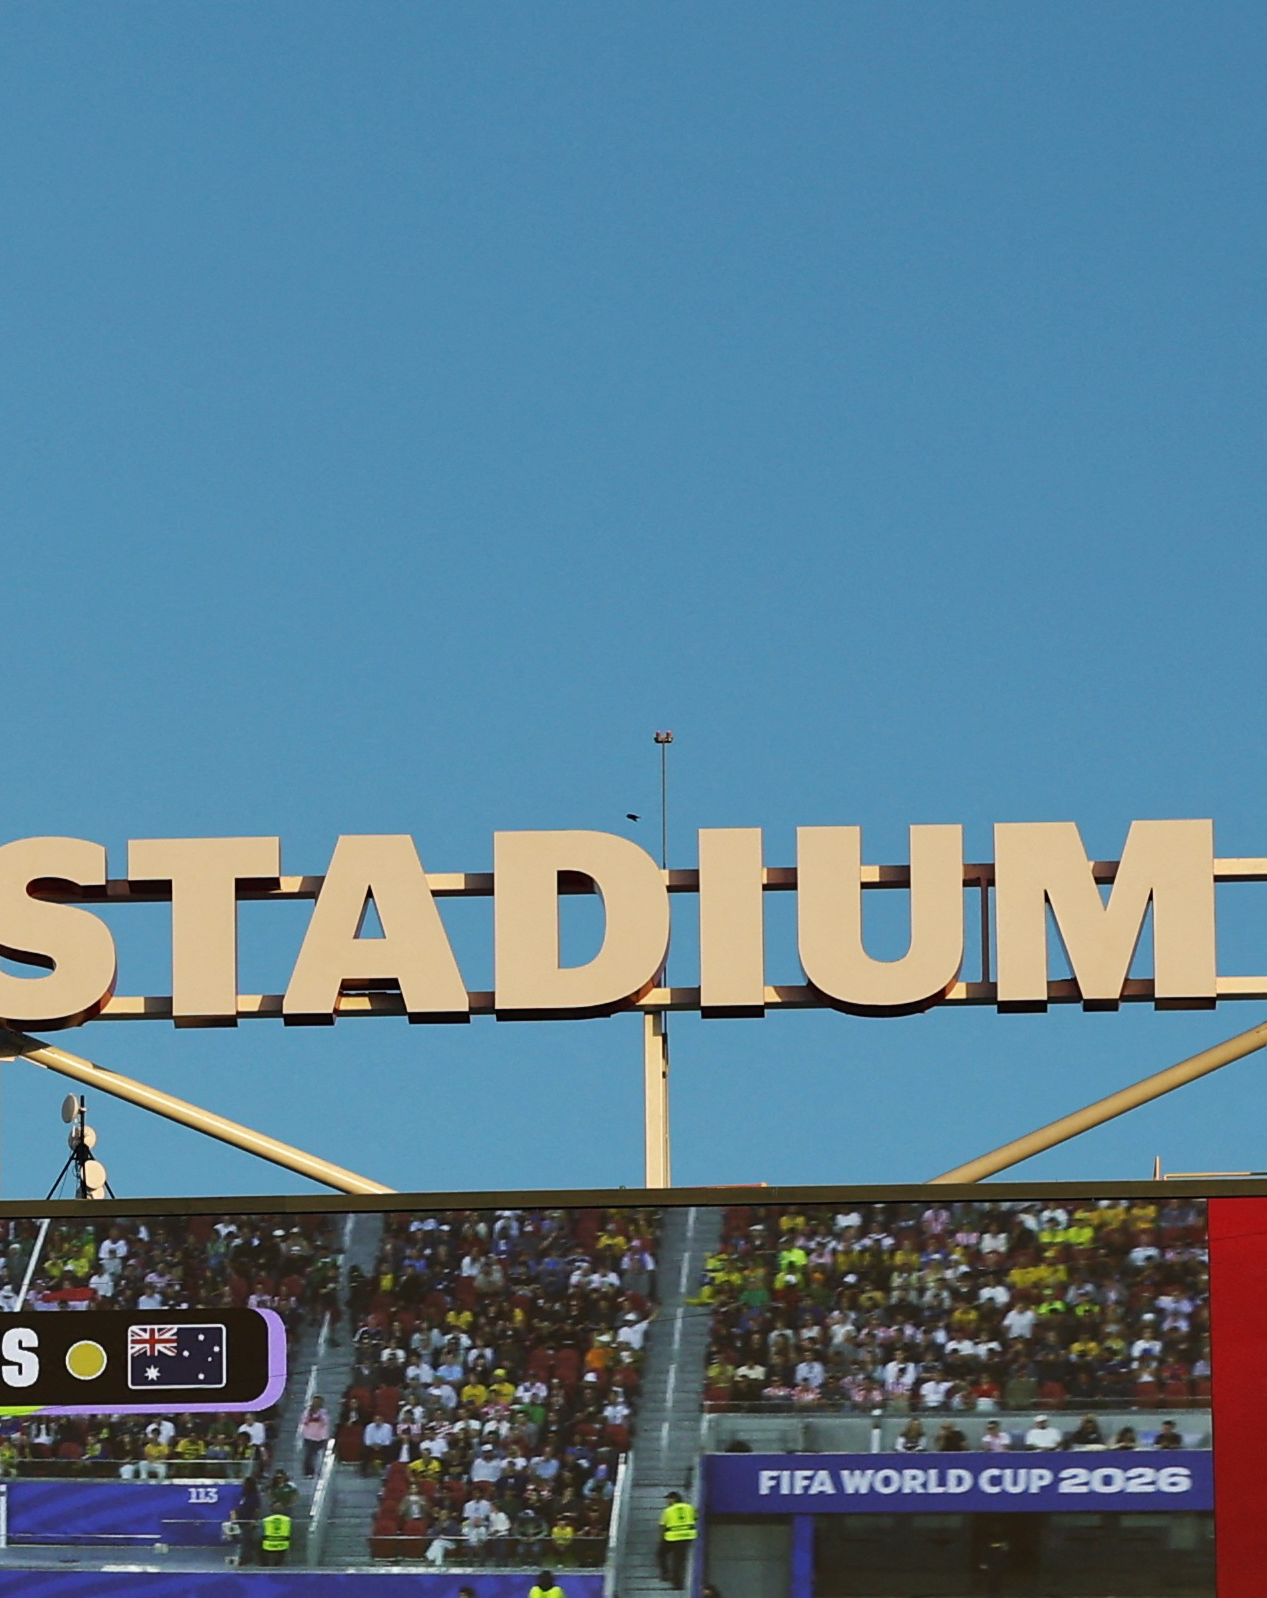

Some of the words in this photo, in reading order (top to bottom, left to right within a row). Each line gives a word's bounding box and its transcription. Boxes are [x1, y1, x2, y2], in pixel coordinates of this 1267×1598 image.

[758, 1470, 837, 1495] FIFA
[839, 1469, 974, 1495] WORLD
[978, 1468, 1054, 1494] CUP
[1057, 1466, 1192, 1494] 2026
[187, 1487, 219, 1504] 113
